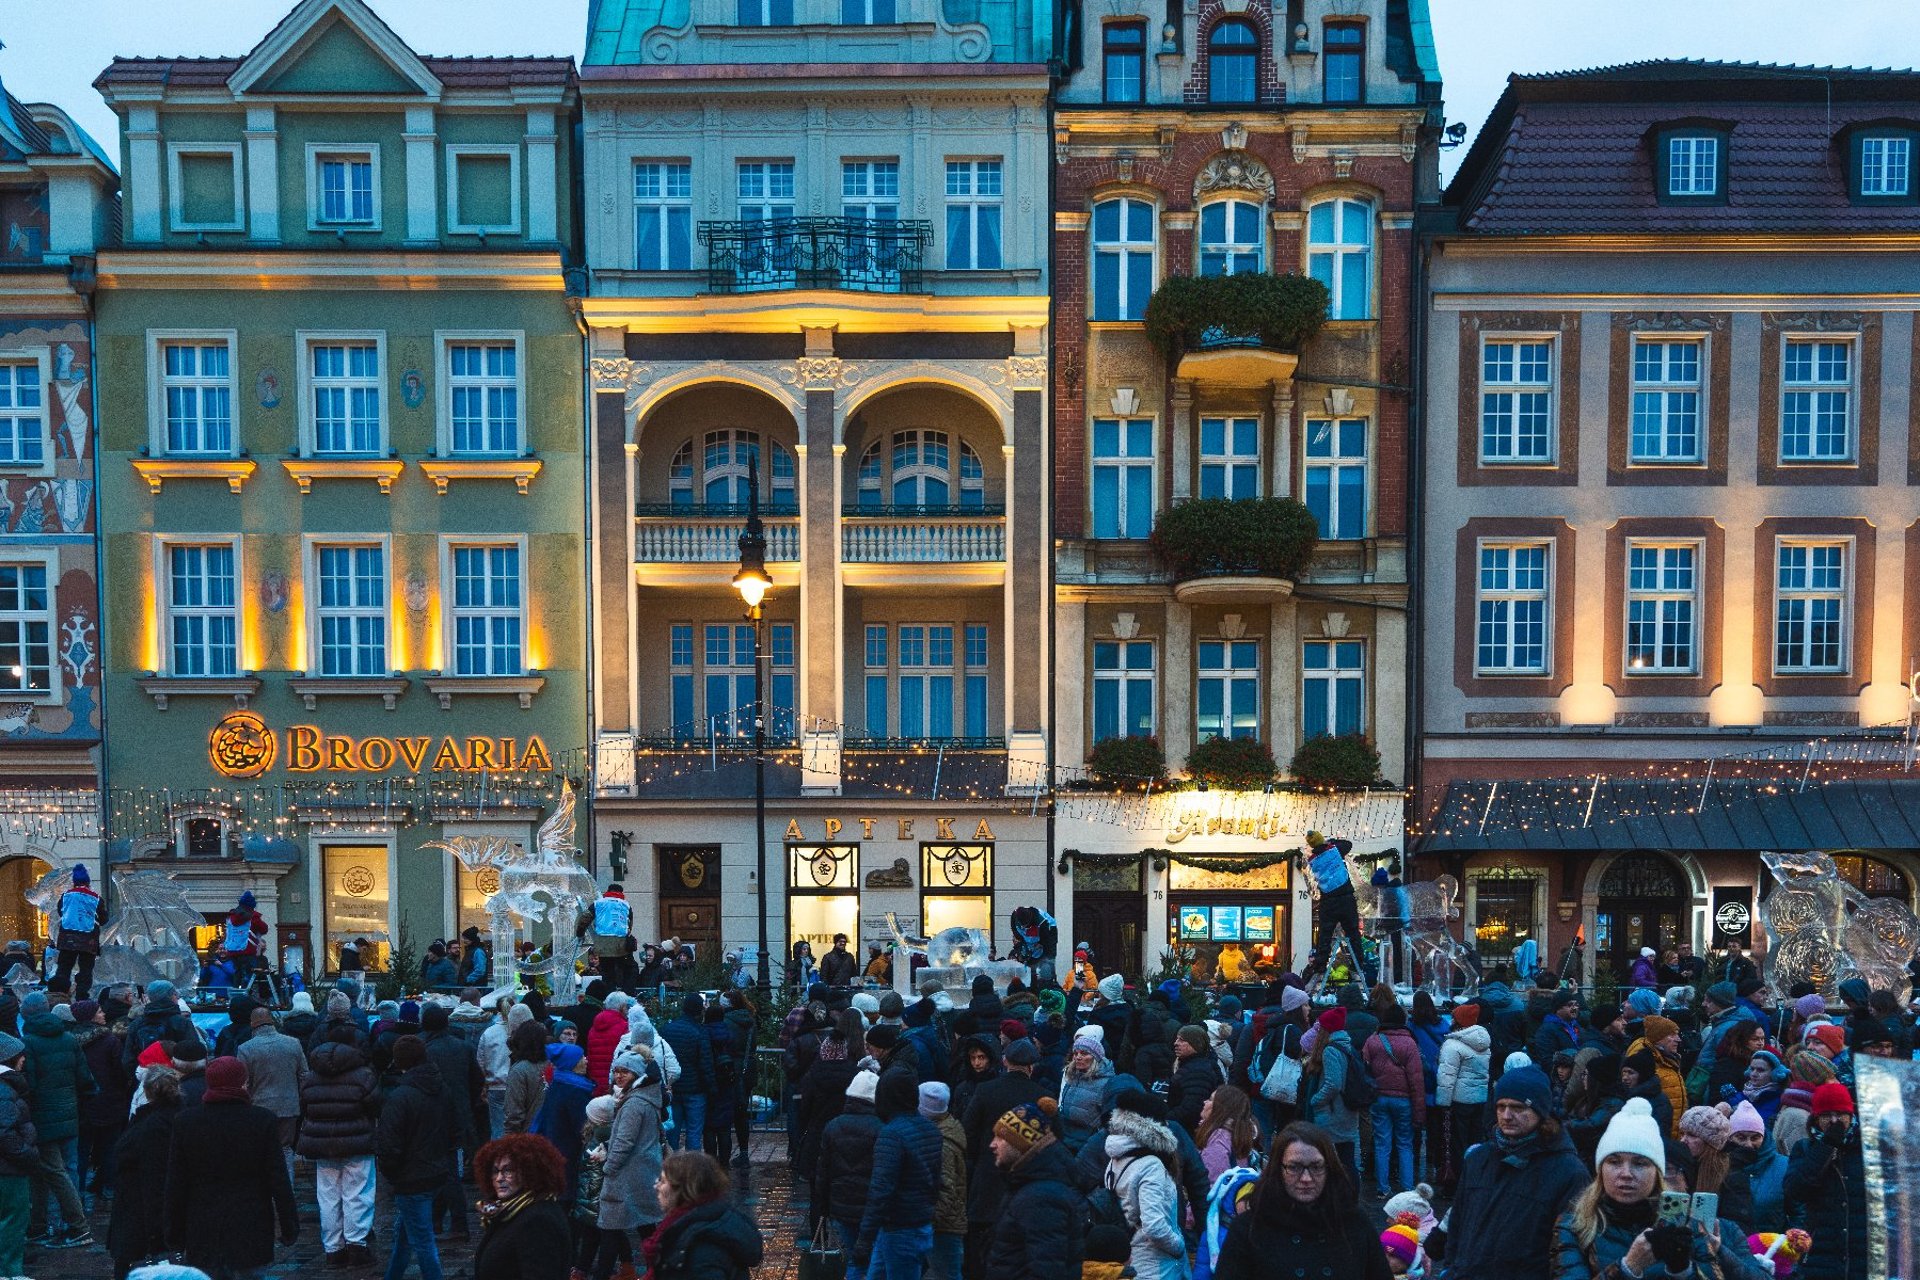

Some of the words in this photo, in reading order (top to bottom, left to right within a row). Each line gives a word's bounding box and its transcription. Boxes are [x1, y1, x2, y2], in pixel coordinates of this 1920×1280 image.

[285, 727, 552, 770] BROVARIA
[366, 780, 418, 790] HOTEL
[782, 818, 996, 840] APTEKA
[1153, 890, 1163, 900] 76
[1298, 890, 1308, 900] 76
[798, 933, 851, 944] APTEA
